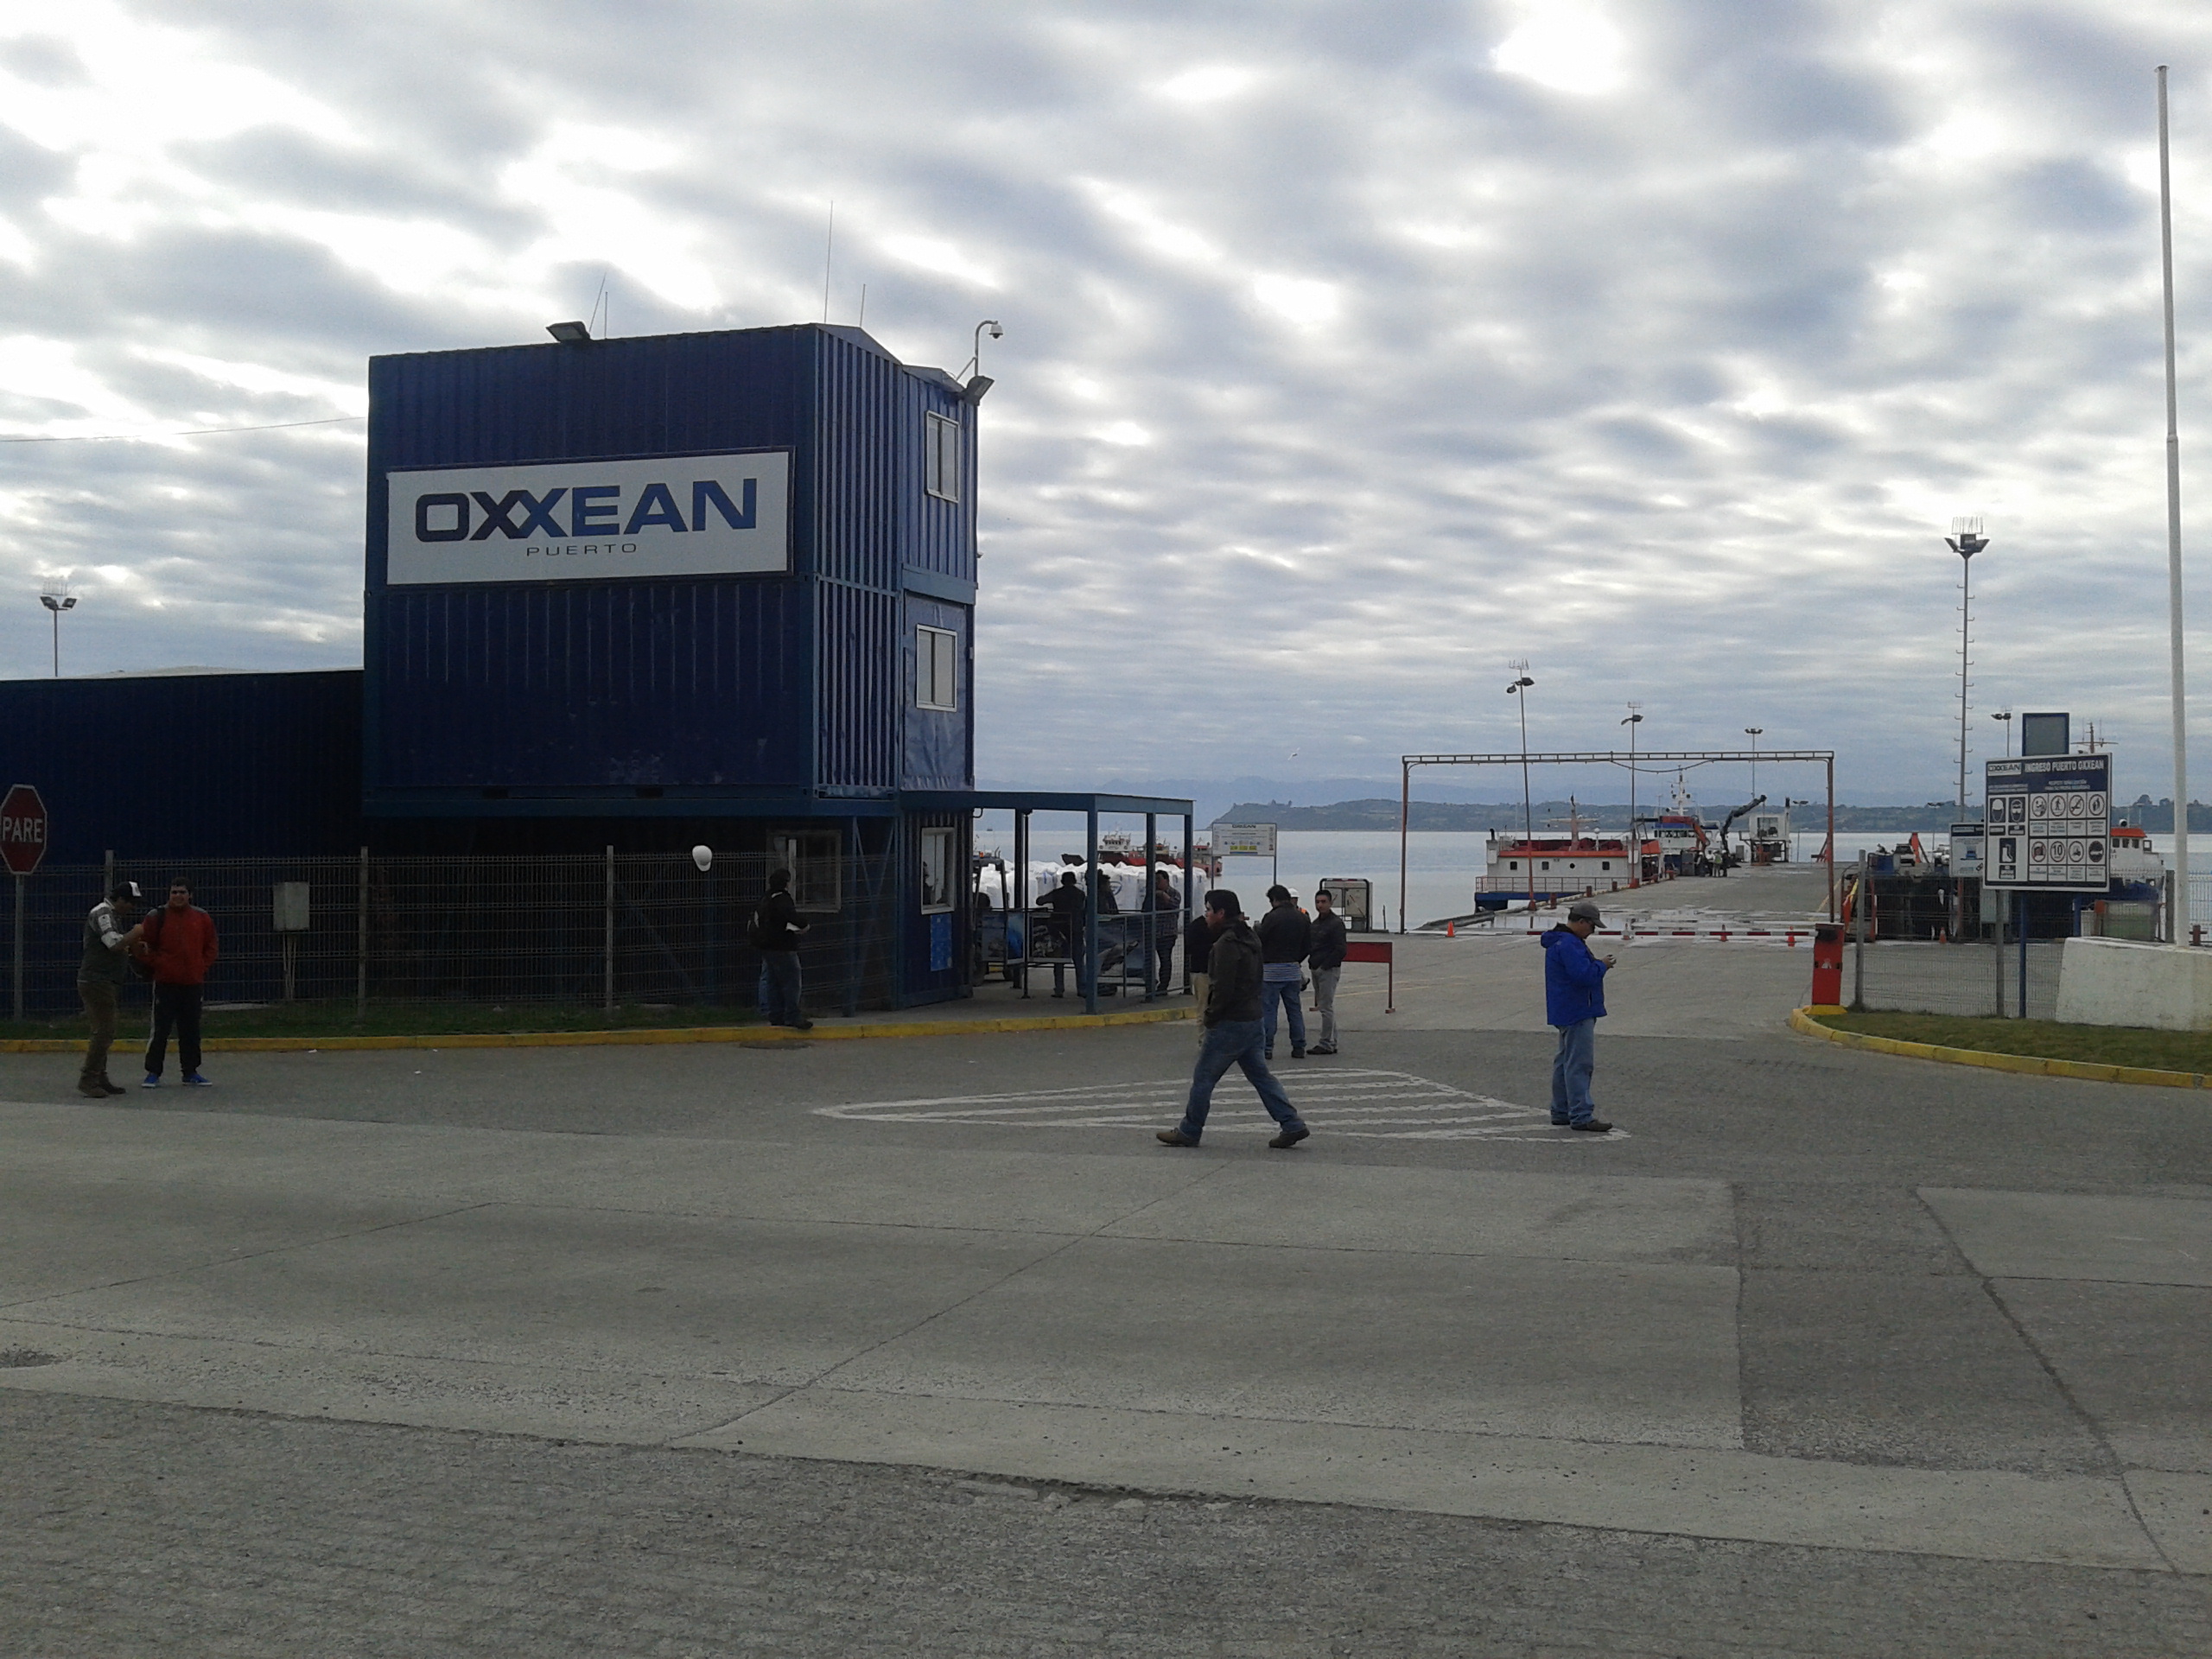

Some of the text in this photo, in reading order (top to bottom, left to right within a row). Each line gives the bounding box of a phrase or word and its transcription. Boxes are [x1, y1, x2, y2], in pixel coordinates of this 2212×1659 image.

[416, 478, 757, 543] OXXEAN
[526, 543, 637, 556] PUERTO
[2024, 760, 2105, 772] INGRESO PUERTO OXXEAN
[2, 817, 43, 842] PARE
[2052, 844, 2063, 855] 10
